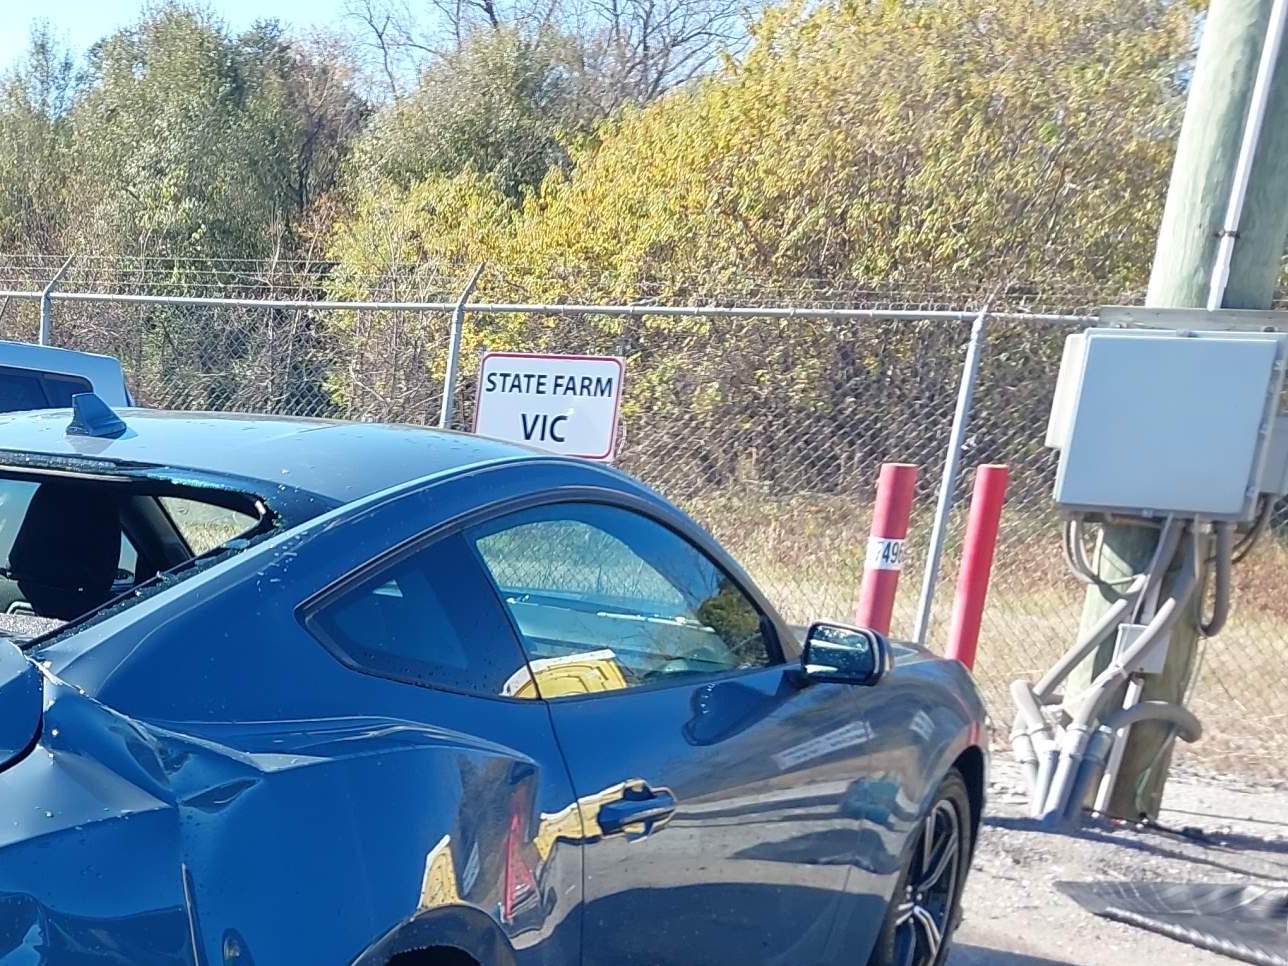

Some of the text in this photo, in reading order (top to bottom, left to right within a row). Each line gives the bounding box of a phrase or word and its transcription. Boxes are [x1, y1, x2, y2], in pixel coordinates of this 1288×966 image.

[485, 372, 613, 398] STATE FARM
[520, 413, 569, 443] VIC
